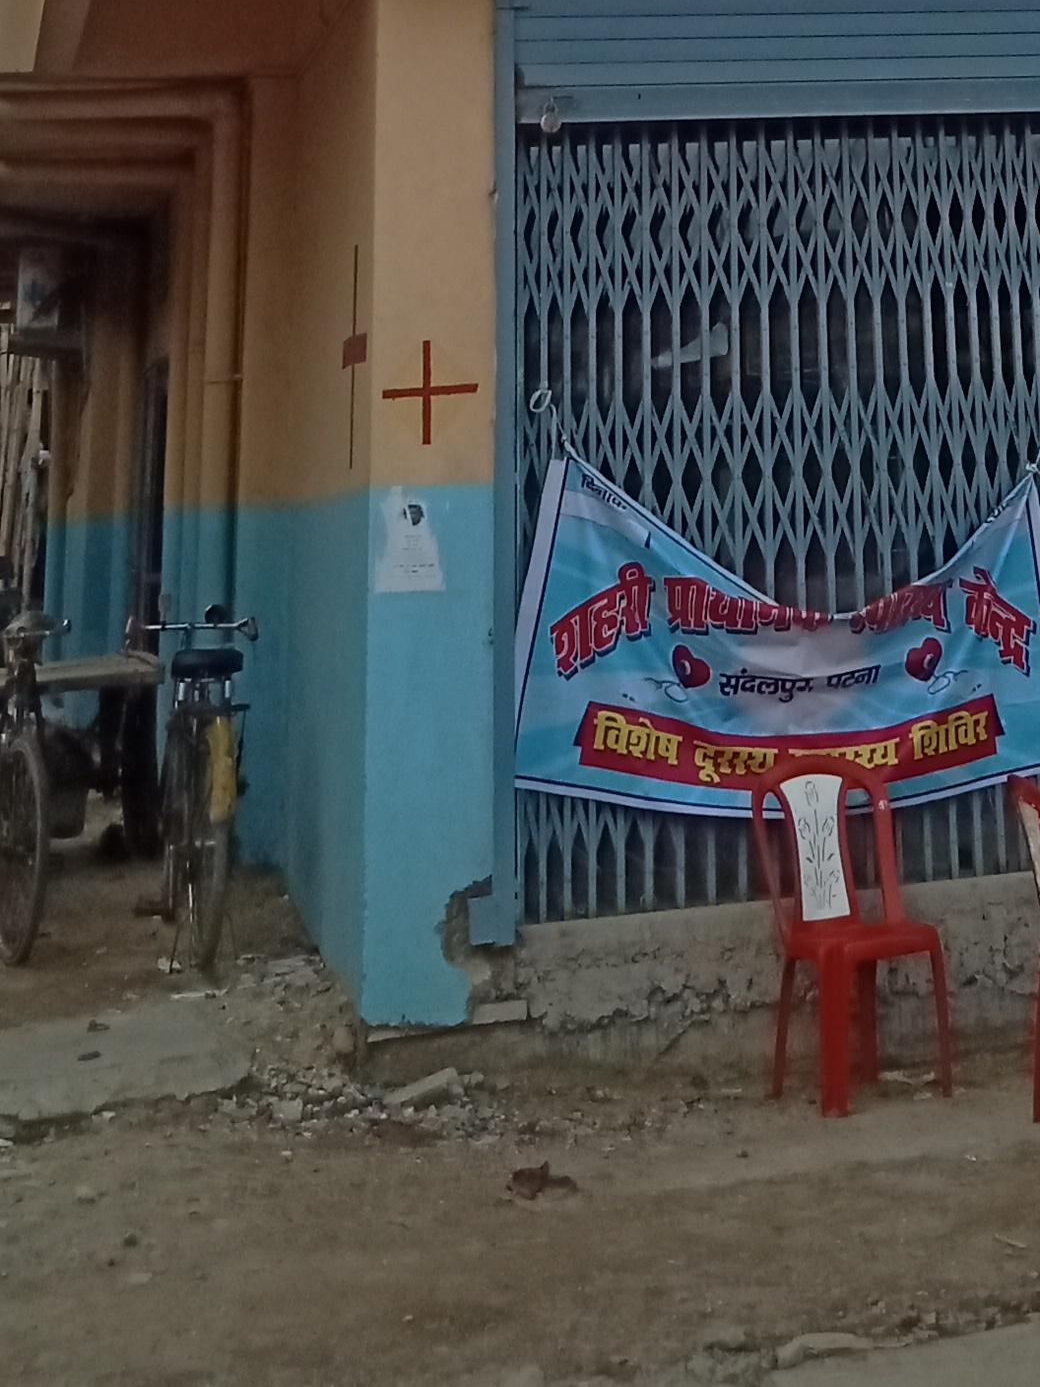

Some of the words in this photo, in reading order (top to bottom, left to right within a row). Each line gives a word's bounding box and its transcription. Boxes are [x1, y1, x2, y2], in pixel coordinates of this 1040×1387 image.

[826, 664, 882, 689] पटना
[593, 710, 683, 767] विशेष
[909, 710, 991, 761] शिविर
